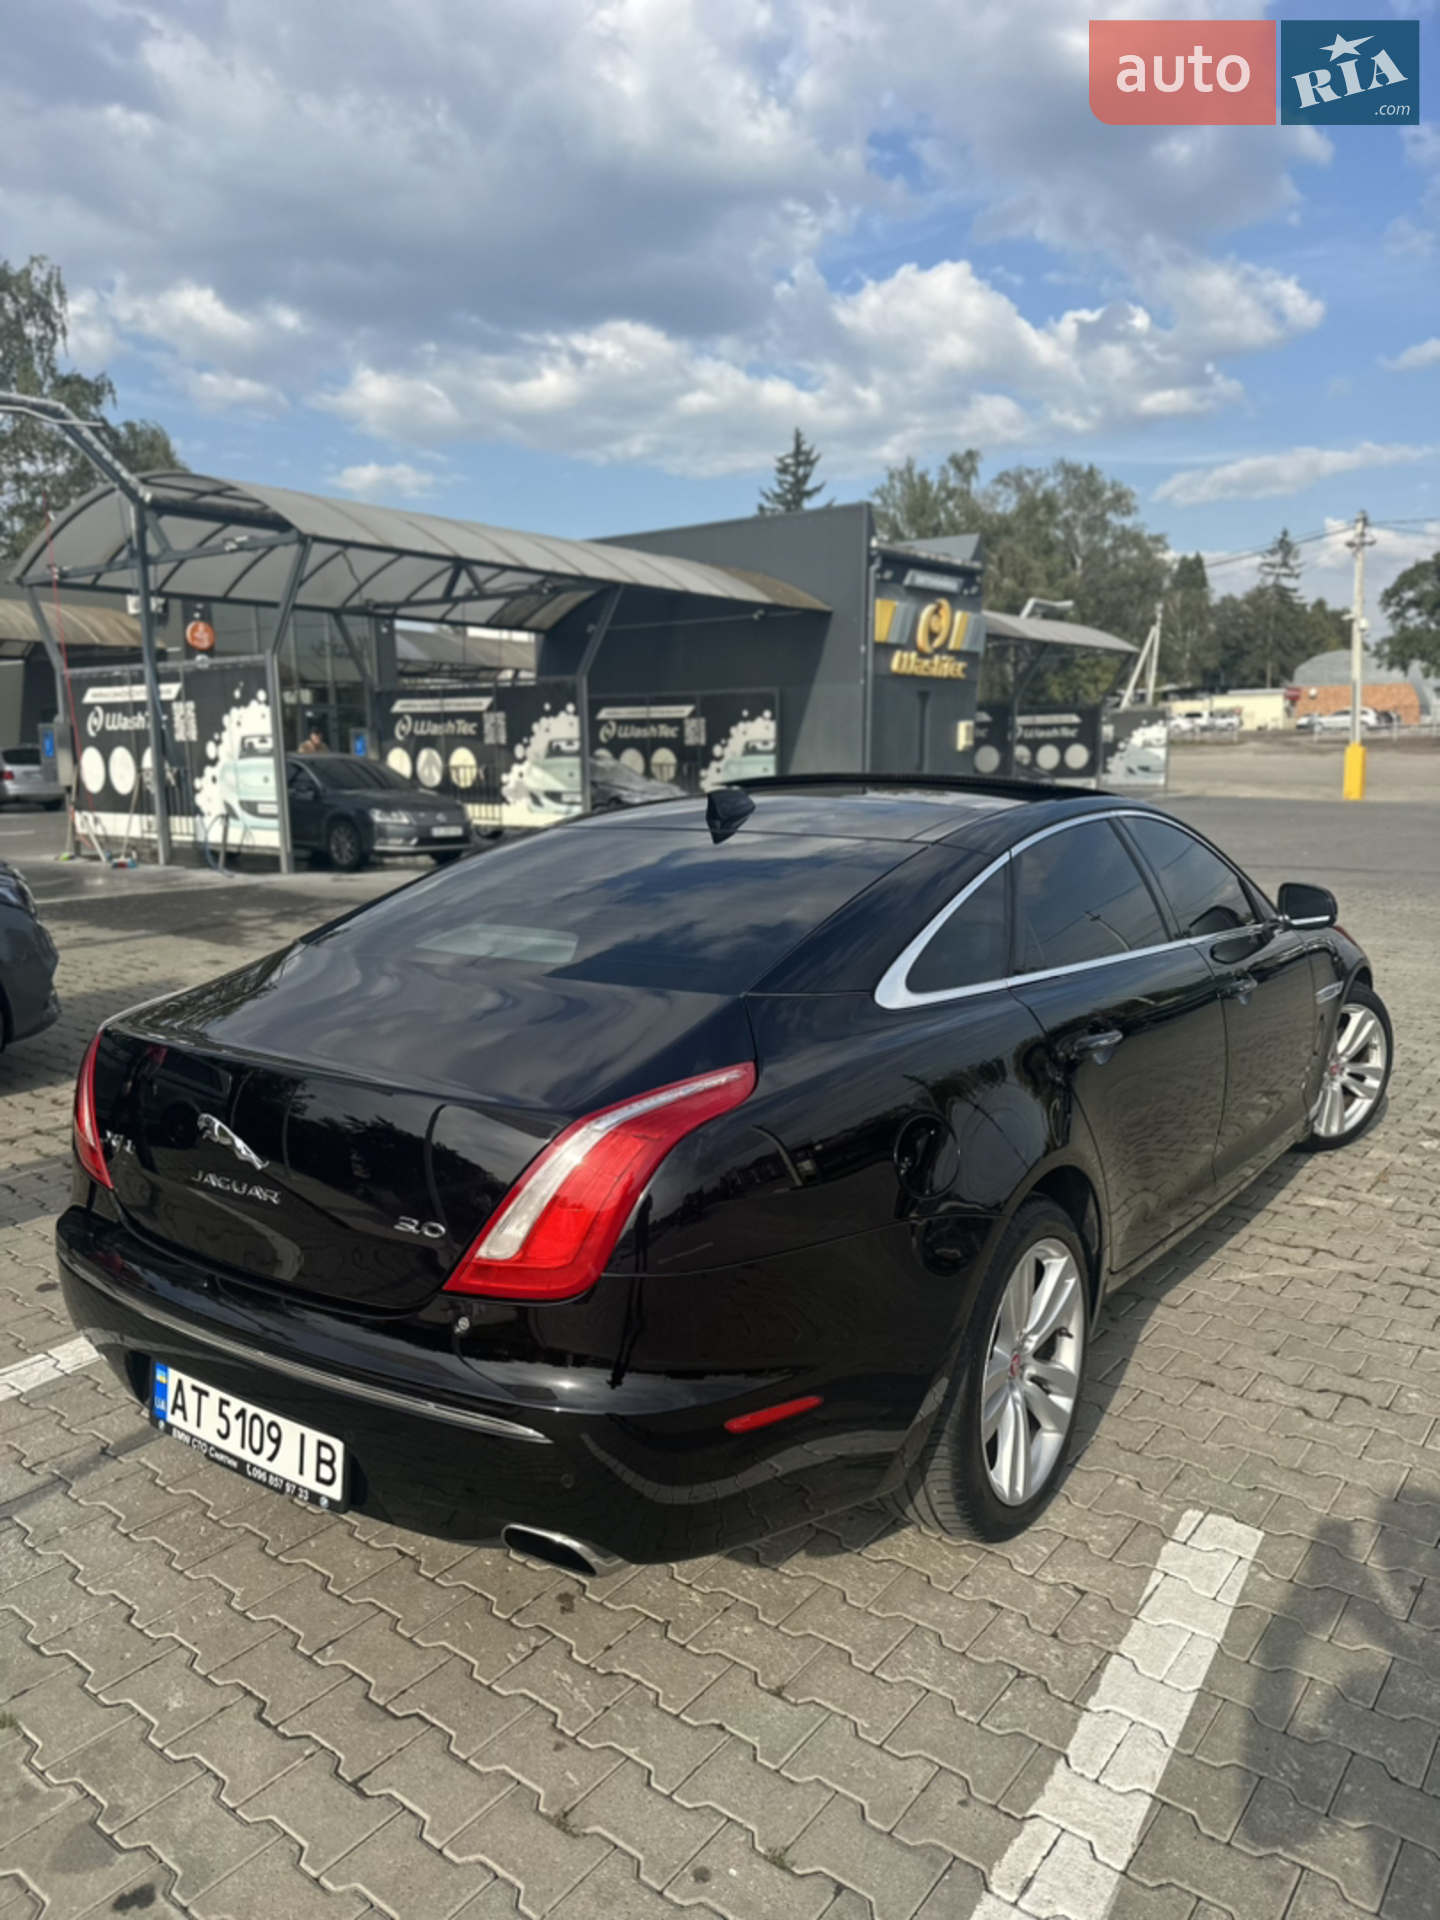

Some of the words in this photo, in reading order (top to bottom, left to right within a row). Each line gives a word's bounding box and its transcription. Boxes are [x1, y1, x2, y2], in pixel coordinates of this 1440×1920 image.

[891, 651, 968, 679] WashTec
[413, 718, 478, 736] WashTec
[617, 723, 679, 738] WashTec
[191, 1170, 281, 1205] JAGUAR
[170, 1378, 210, 1429] AT
[216, 1396, 283, 1463] 5109
[298, 1432, 337, 1487] IB
